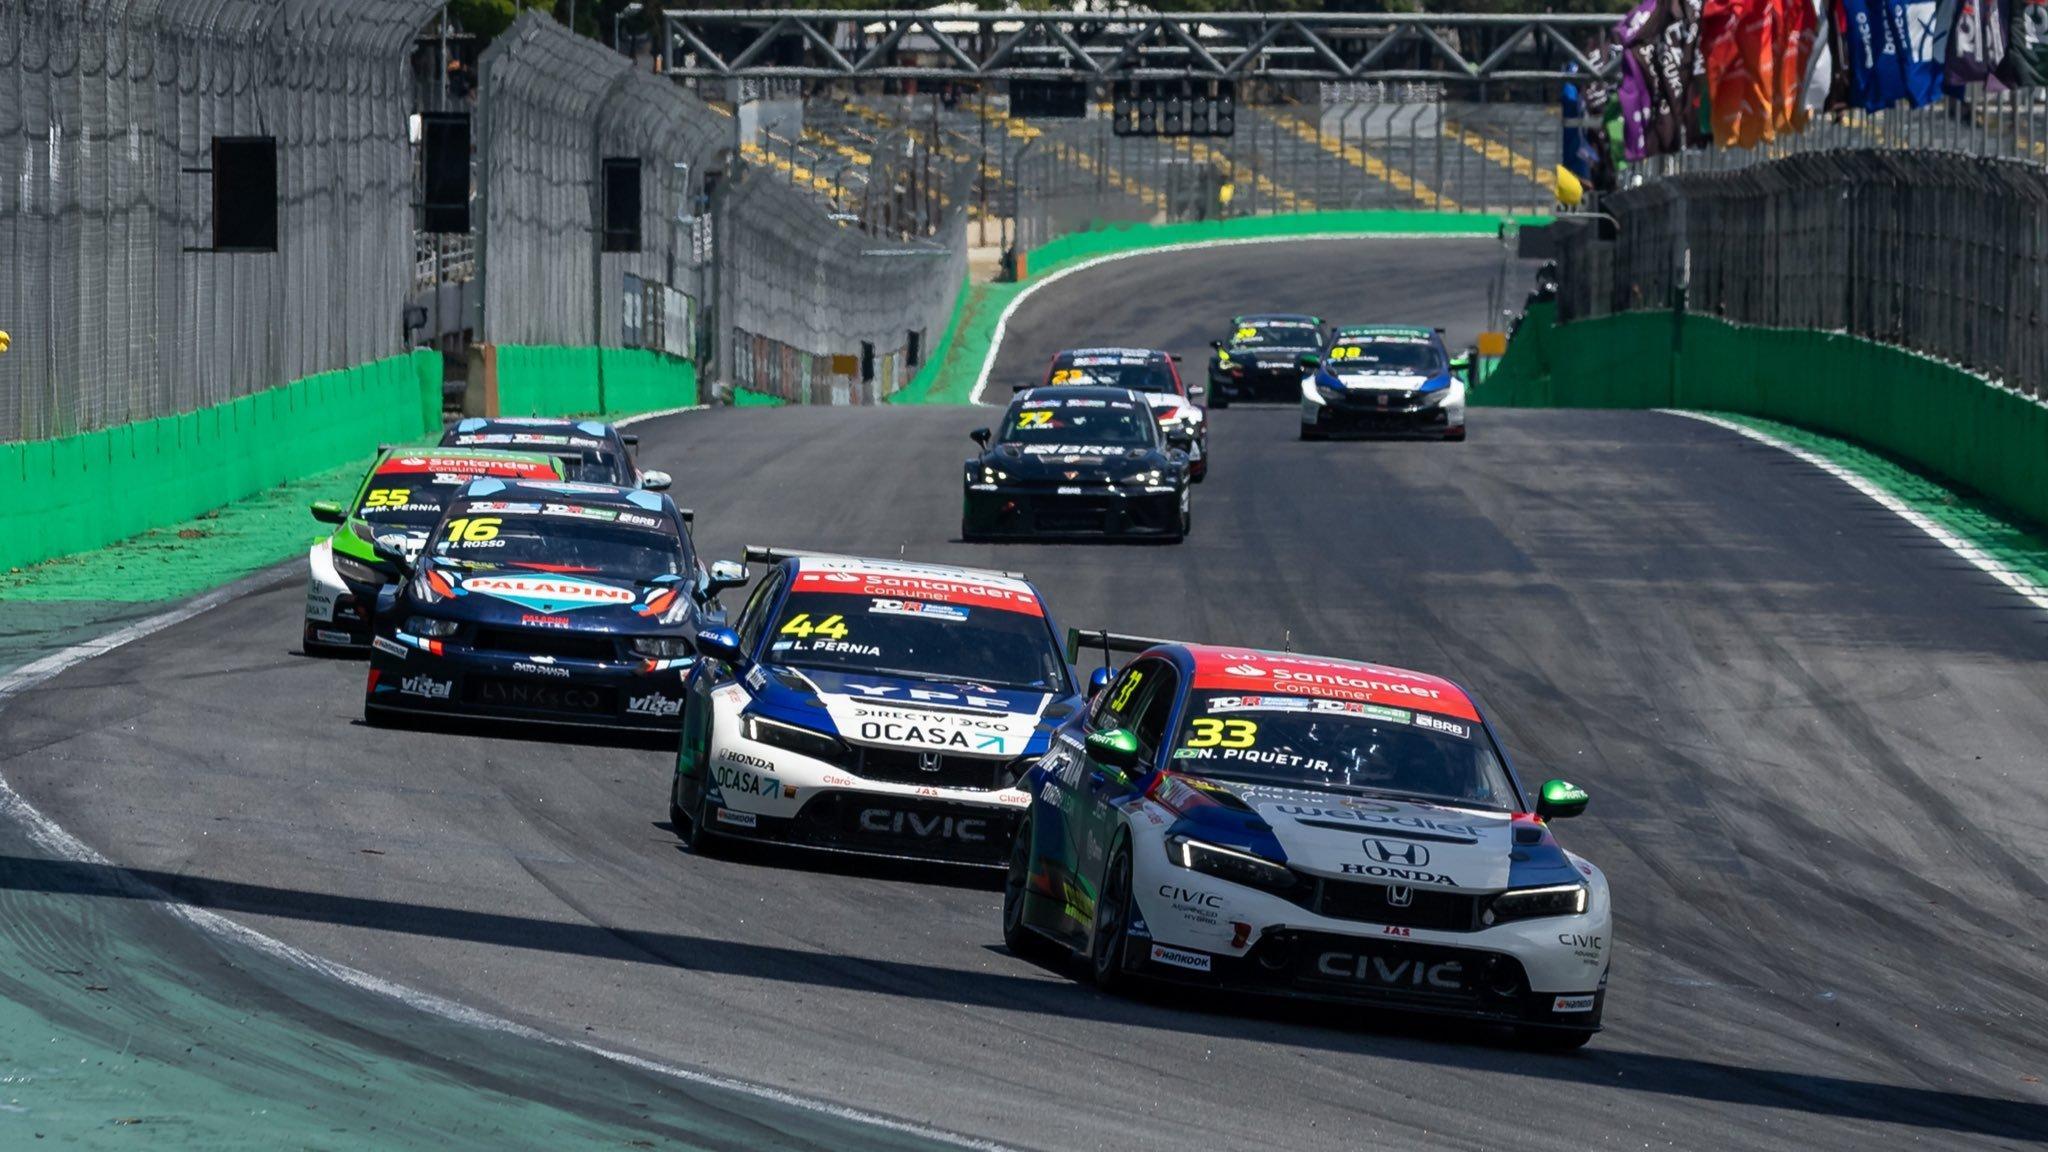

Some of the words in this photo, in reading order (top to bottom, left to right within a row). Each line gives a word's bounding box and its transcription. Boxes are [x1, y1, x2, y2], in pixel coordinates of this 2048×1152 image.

[428, 466, 487, 474] Consume
[429, 458, 537, 471] Santander
[366, 489, 411, 507] 55
[375, 504, 390, 512] M.
[393, 503, 441, 512] PERNIA
[448, 517, 503, 542] 16
[463, 540, 506, 548] ROSSO
[471, 579, 629, 601] PALADINI
[864, 585, 952, 601] Consumer
[865, 574, 1013, 599] Santander
[872, 599, 922, 612] TCR
[780, 613, 849, 639] 44
[794, 640, 808, 651] L.
[813, 641, 881, 657] PERNIA
[844, 683, 1010, 708] YPF
[1273, 668, 1441, 699] Santander
[1273, 681, 1374, 701] Consumer
[854, 708, 946, 723] DIRECTV
[1208, 696, 1262, 706] TCR
[1312, 699, 1364, 712] TCR
[1432, 719, 1463, 735] BRB
[861, 722, 970, 748] OCASA
[1187, 717, 1258, 748] 33
[727, 750, 776, 772] HONDA
[1197, 748, 1218, 760] N.
[1223, 749, 1303, 766] PIQUET
[1304, 757, 1333, 773] JR.
[717, 766, 760, 796] OCASA
[822, 775, 852, 787] Claro
[914, 787, 939, 797] JAS
[999, 793, 1028, 804] Claro
[859, 808, 987, 841] CIVIC
[1340, 863, 1461, 888] HONDA
[1158, 885, 1224, 909] CIVIC
[1382, 925, 1411, 937] JAS
[1558, 933, 1602, 950] CIVIC
[1317, 951, 1463, 989] CIVIC
